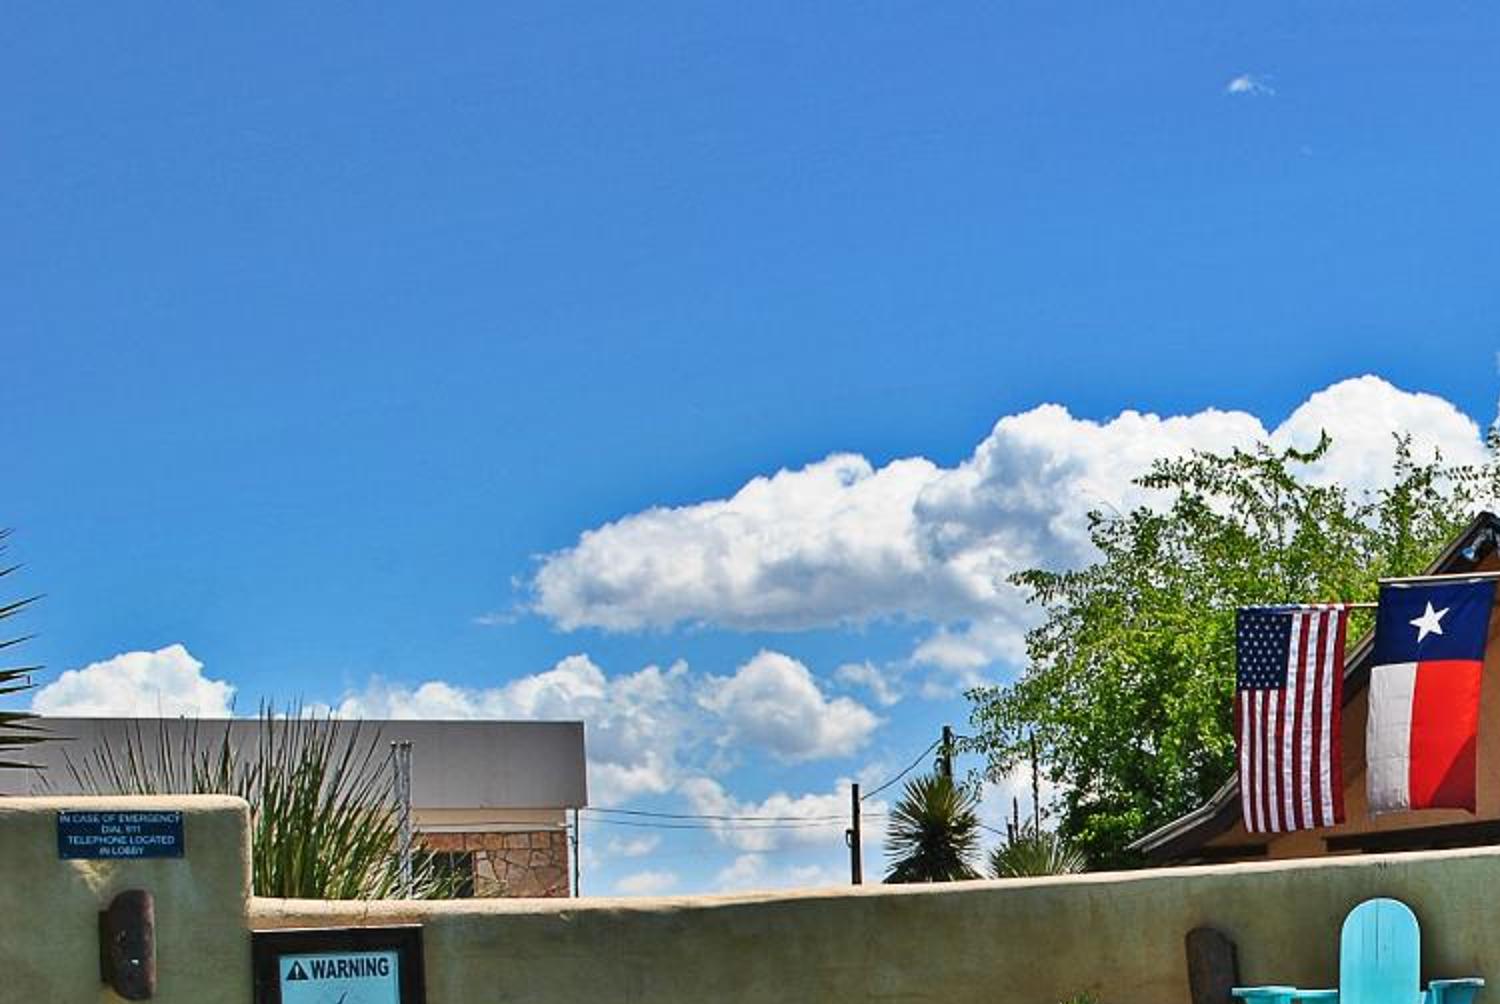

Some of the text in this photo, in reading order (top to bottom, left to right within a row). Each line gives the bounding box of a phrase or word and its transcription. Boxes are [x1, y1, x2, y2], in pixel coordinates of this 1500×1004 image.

[59, 814, 179, 824] IN CASE OF EMERGENCY
[68, 836, 175, 845] TELEPHONE LOCATED
[99, 846, 111, 855] IN
[310, 957, 390, 980] WARNING
